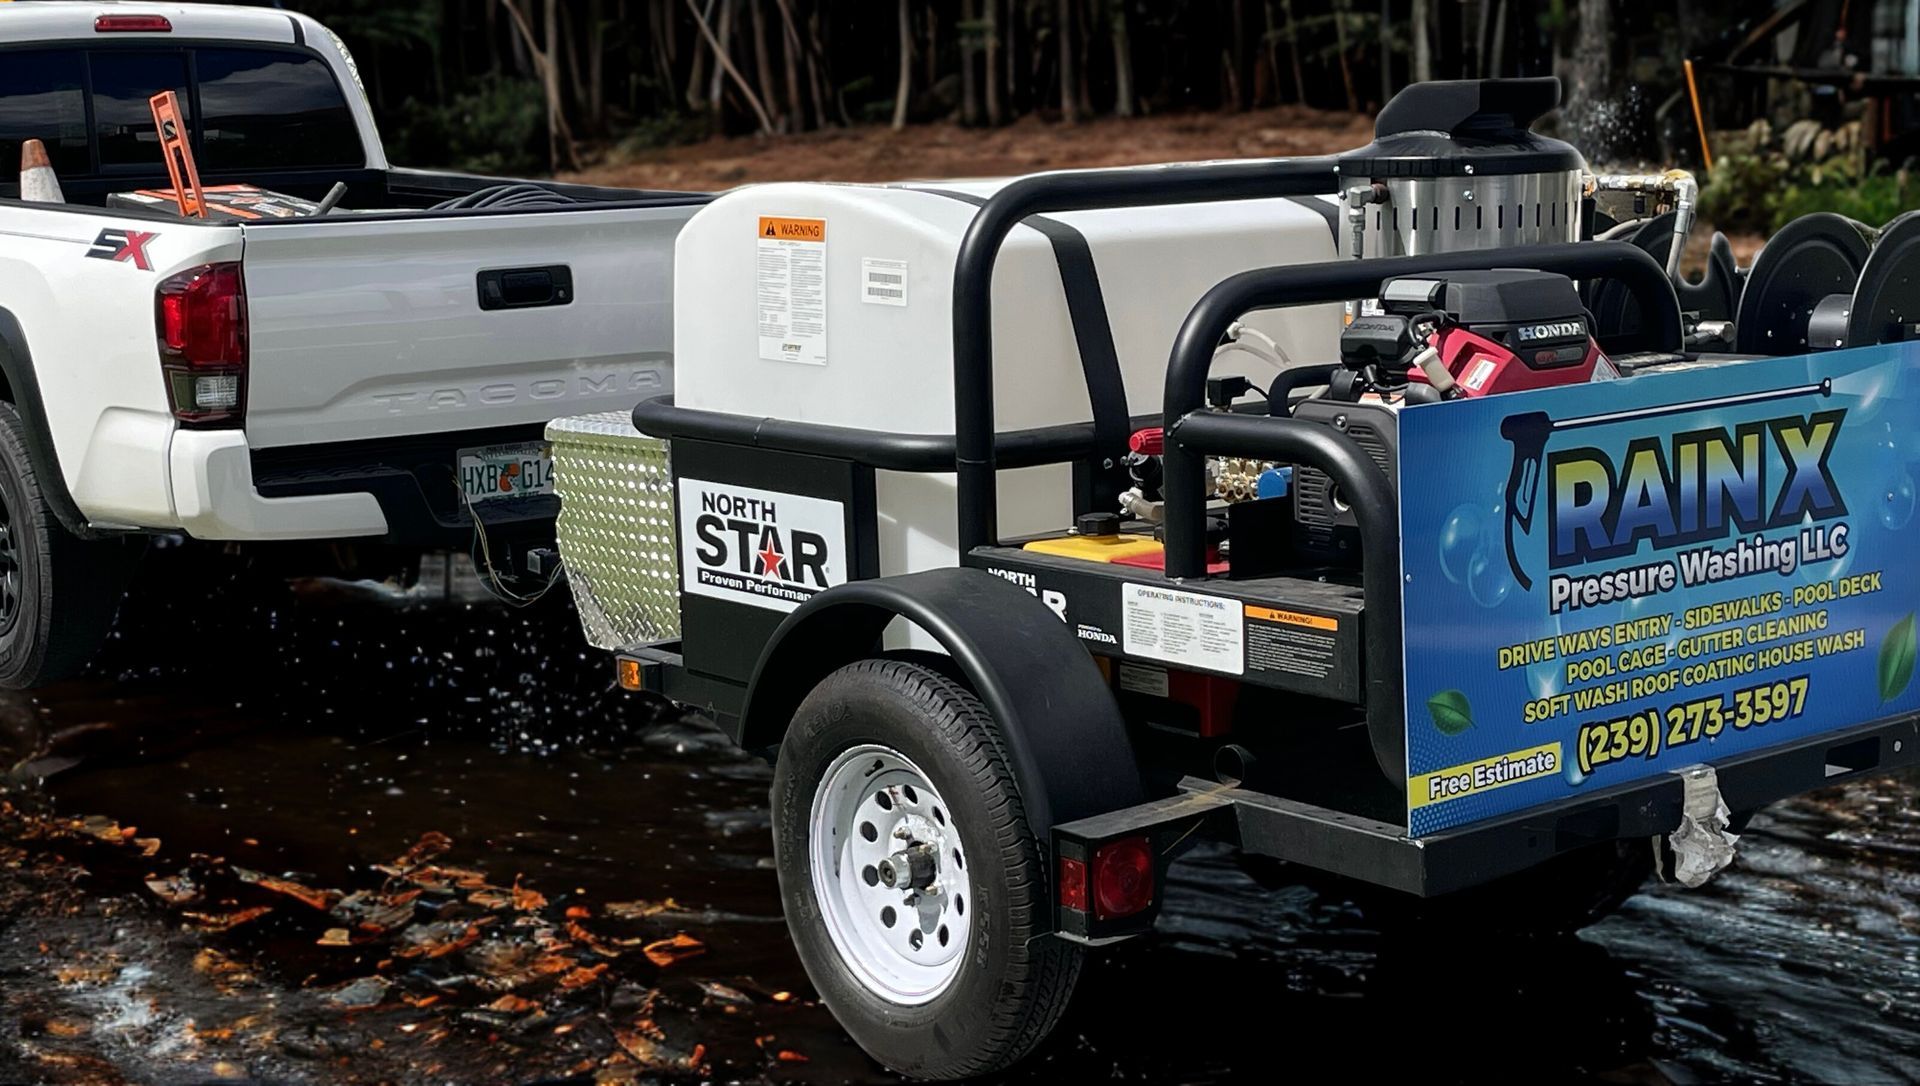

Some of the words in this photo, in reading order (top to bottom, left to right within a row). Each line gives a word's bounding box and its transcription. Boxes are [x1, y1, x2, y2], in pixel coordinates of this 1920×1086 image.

[84, 228, 162, 272] SX
[781, 223, 819, 237] WARNING
[1518, 321, 1586, 341] HONDA
[372, 369, 662, 413] TACOMA
[462, 464, 498, 495] HXB
[521, 459, 554, 489] G14
[1550, 424, 1763, 567] RAIN
[1770, 412, 1845, 522] X
[701, 491, 777, 523] NORTH
[696, 513, 830, 589] STAR
[1550, 561, 1677, 613] Pressure
[1680, 534, 1797, 587] Washing
[1800, 522, 1849, 562] LLC
[701, 571, 743, 591] Proven
[746, 580, 812, 601] Performan
[1137, 589, 1174, 602] OPERATING
[1077, 629, 1117, 644] HONDA
[1277, 612, 1313, 625] WARNING!
[1498, 638, 1555, 670] DRIVE
[1557, 627, 1612, 657] WAYS
[1615, 613, 1673, 645] ENTRY
[1683, 591, 1783, 630] SIDEWALKS
[1793, 582, 1836, 609] POOL
[1839, 572, 1882, 598] DECK
[1567, 655, 1616, 686] POOL
[1617, 643, 1666, 674] CAGE
[1677, 627, 1744, 661] GUTTER
[1746, 610, 1828, 645] CLEANING
[1524, 693, 1572, 724] SOFT
[1573, 681, 1628, 712] WASH
[1631, 669, 1680, 699] ROOF
[1682, 654, 1755, 687] COATING
[1758, 639, 1814, 670] HOUSE
[1816, 629, 1866, 657] WASH
[1576, 710, 1661, 774] (239)
[1667, 678, 1811, 748] 273-3597
[1428, 773, 1472, 800] Free
[1473, 752, 1557, 788] Estimate
